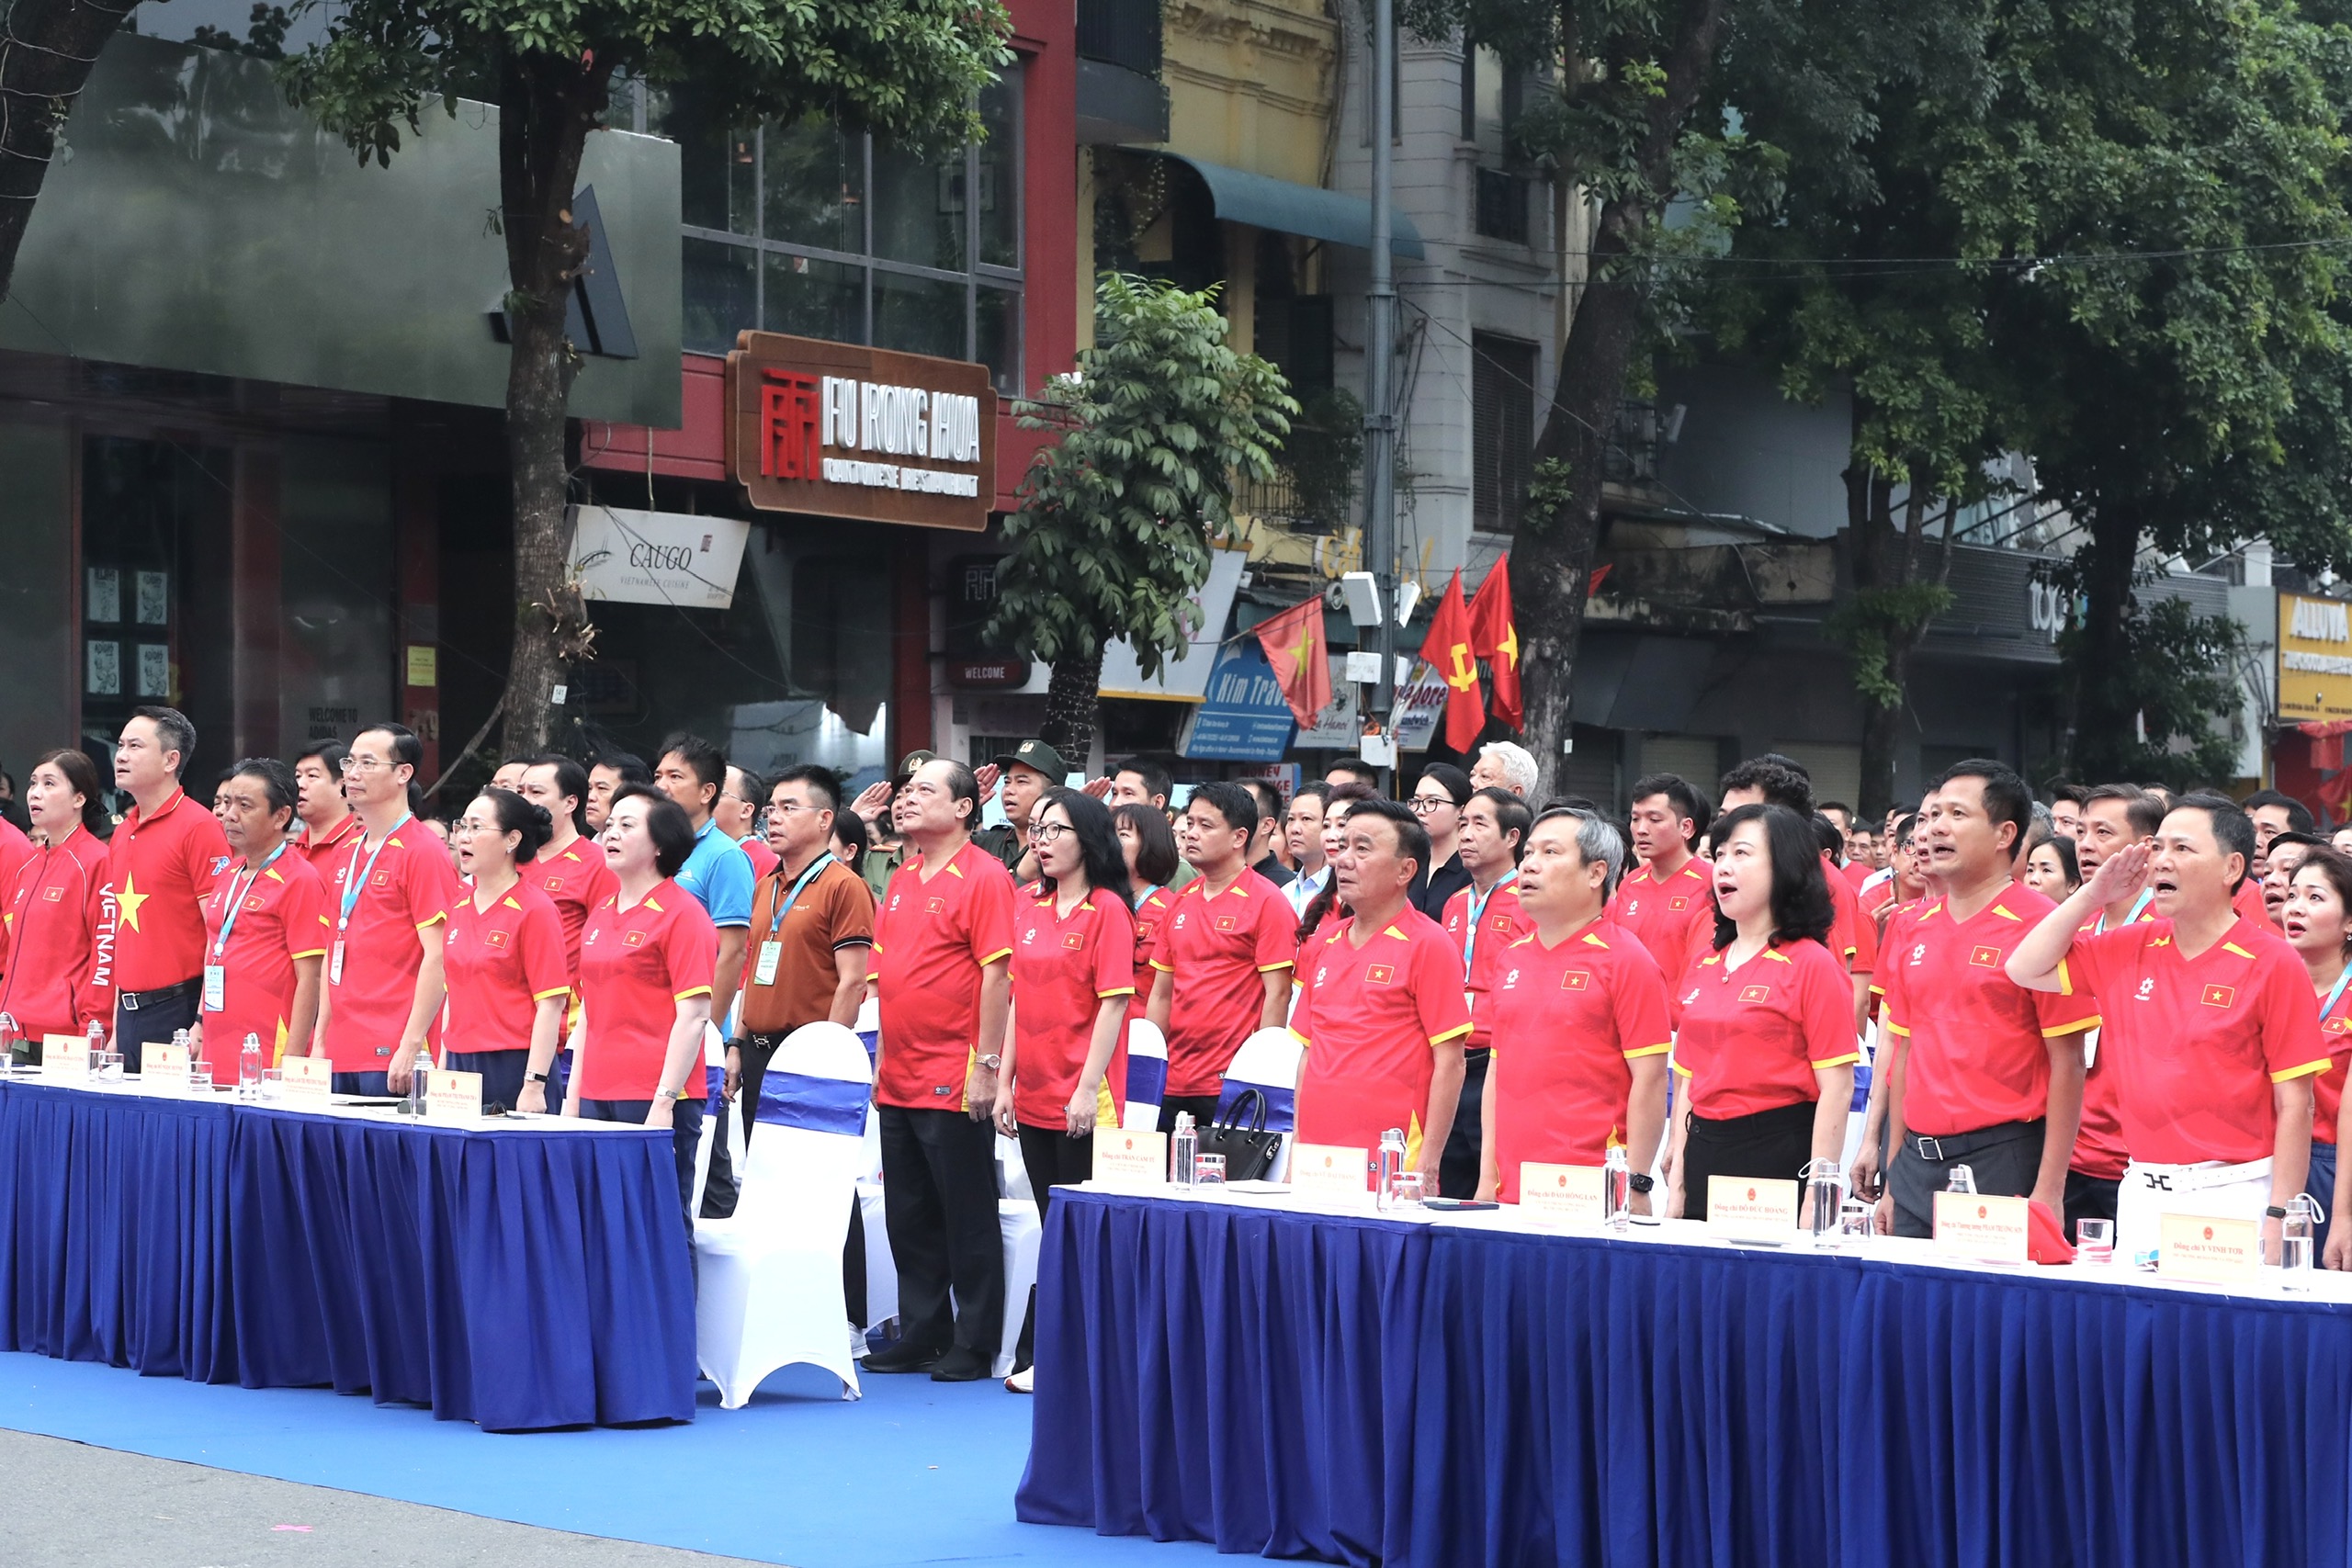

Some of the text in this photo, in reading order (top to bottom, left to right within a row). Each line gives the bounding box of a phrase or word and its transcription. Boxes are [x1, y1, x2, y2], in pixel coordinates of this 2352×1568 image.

[823, 376, 857, 448] FU
[861, 382, 928, 456] RONG
[931, 391, 980, 462] HUA
[823, 457, 978, 497] CANTONESE RESTAURANT
[629, 542, 693, 570] CAUGO
[662, 579, 689, 590] CUISINE
[965, 667, 1005, 679] WELCOME
[1216, 672, 1249, 705] Kim
[309, 706, 347, 723] WELCOME
[91, 882, 117, 987] VIETNAM
